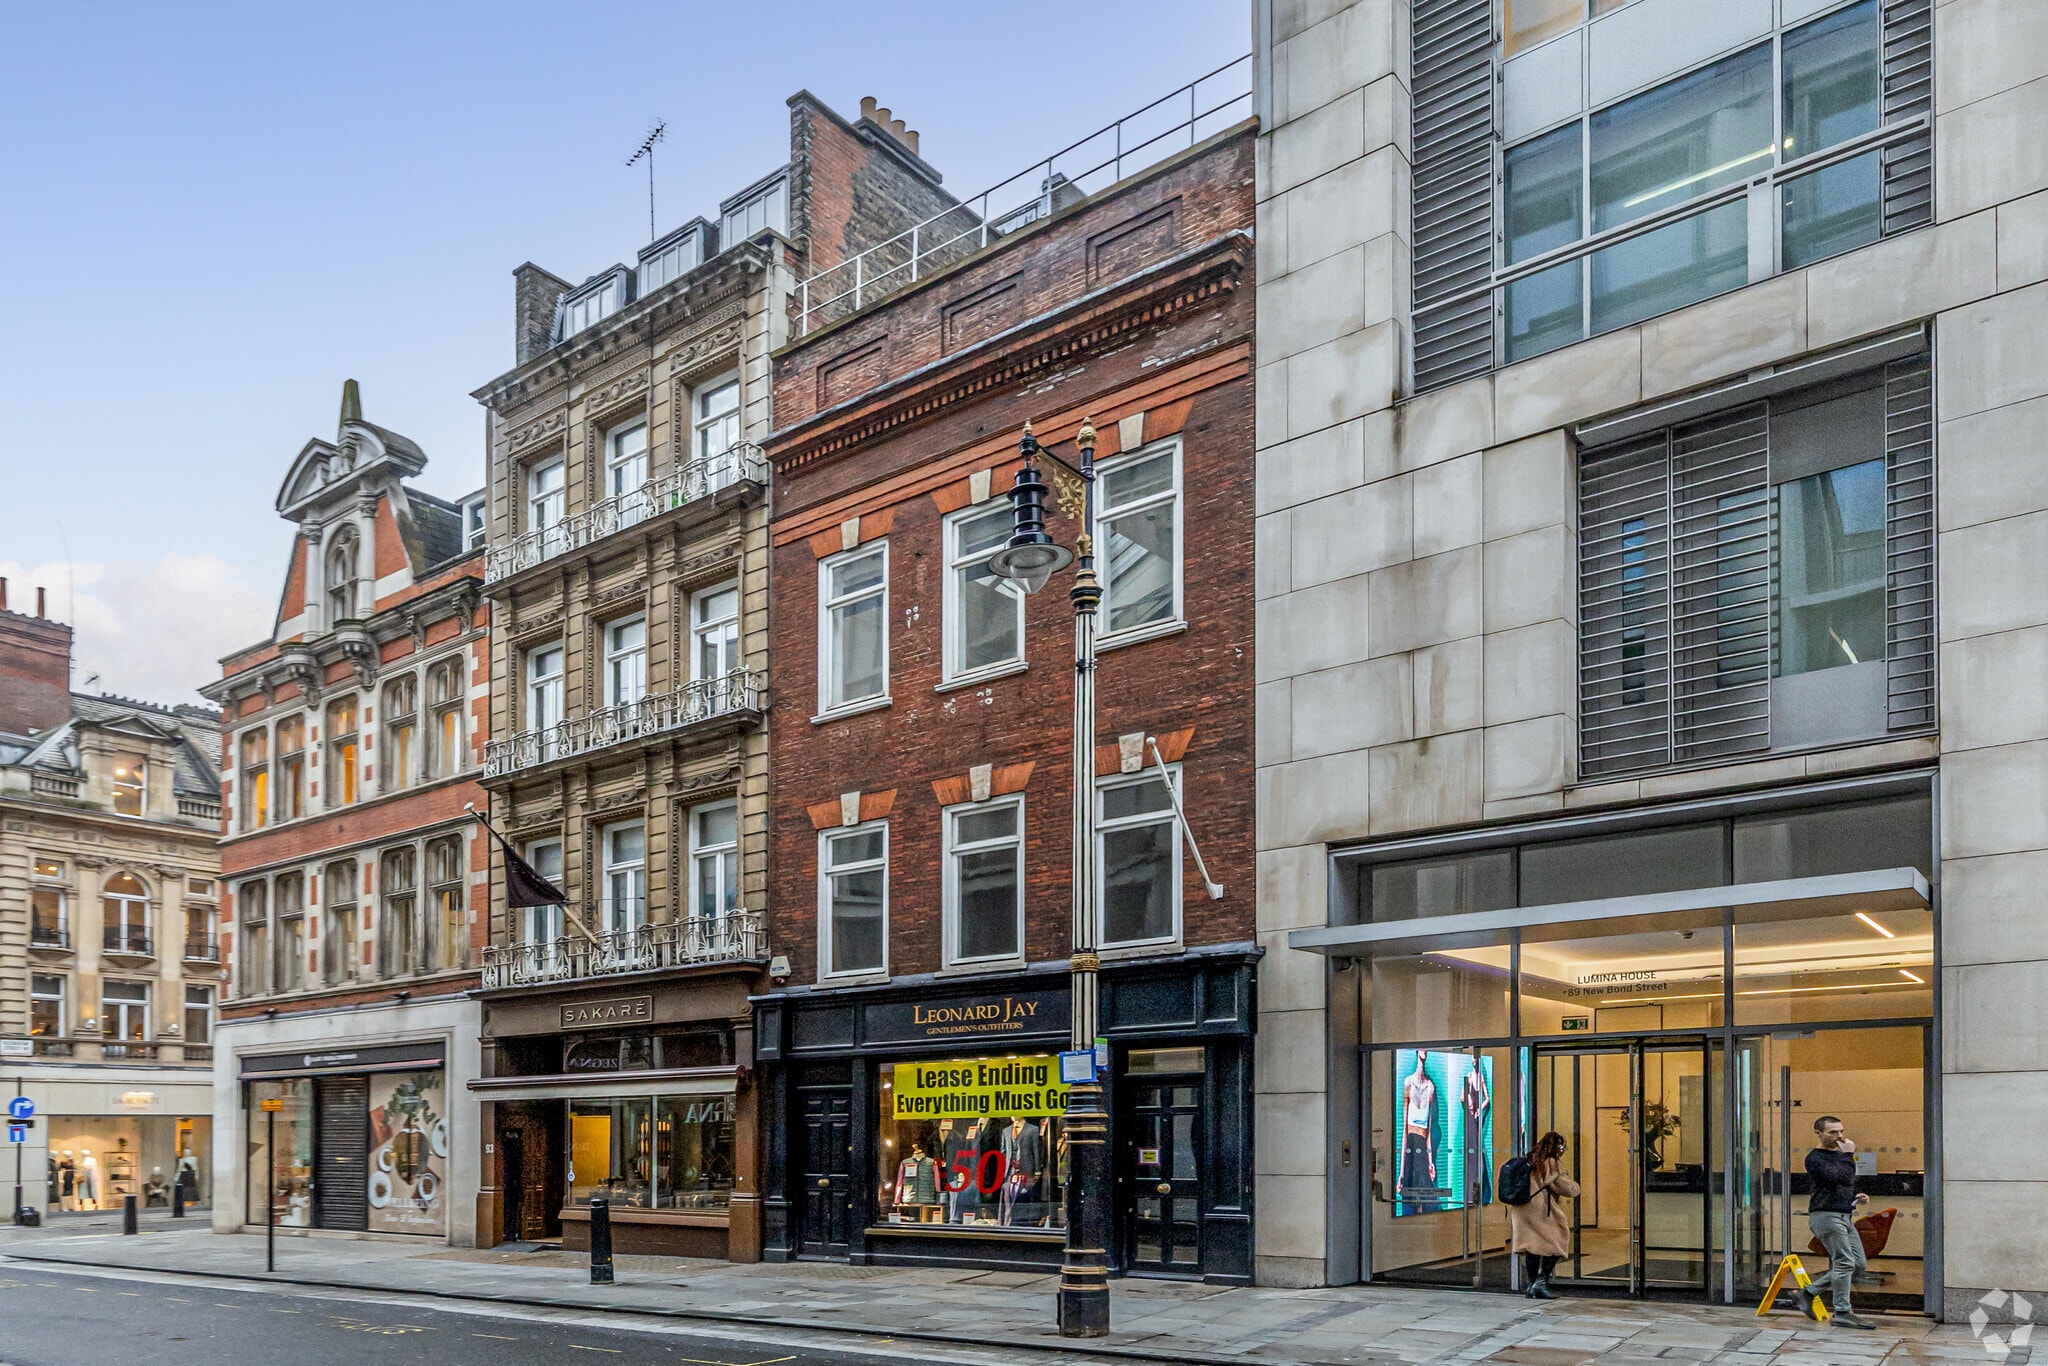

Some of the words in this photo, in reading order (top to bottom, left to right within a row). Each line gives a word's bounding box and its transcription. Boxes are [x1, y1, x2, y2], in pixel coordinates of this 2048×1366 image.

[1577, 974, 1617, 984] LUMINA
[1620, 971, 1657, 981] HOUSE
[1583, 987, 1604, 996] New
[1606, 985, 1633, 994] Bond
[1635, 982, 1668, 992] Street
[565, 1001, 646, 1021] SAKARÉ
[926, 1024, 977, 1035] GENTLEMEN'S
[978, 1022, 1024, 1031] OUTFITTERS
[916, 1067, 972, 1088] Lease
[978, 1063, 1047, 1086] Ending
[897, 1092, 990, 1114] Everything
[995, 1091, 1041, 1111] Must
[485, 1143, 494, 1153] 93
